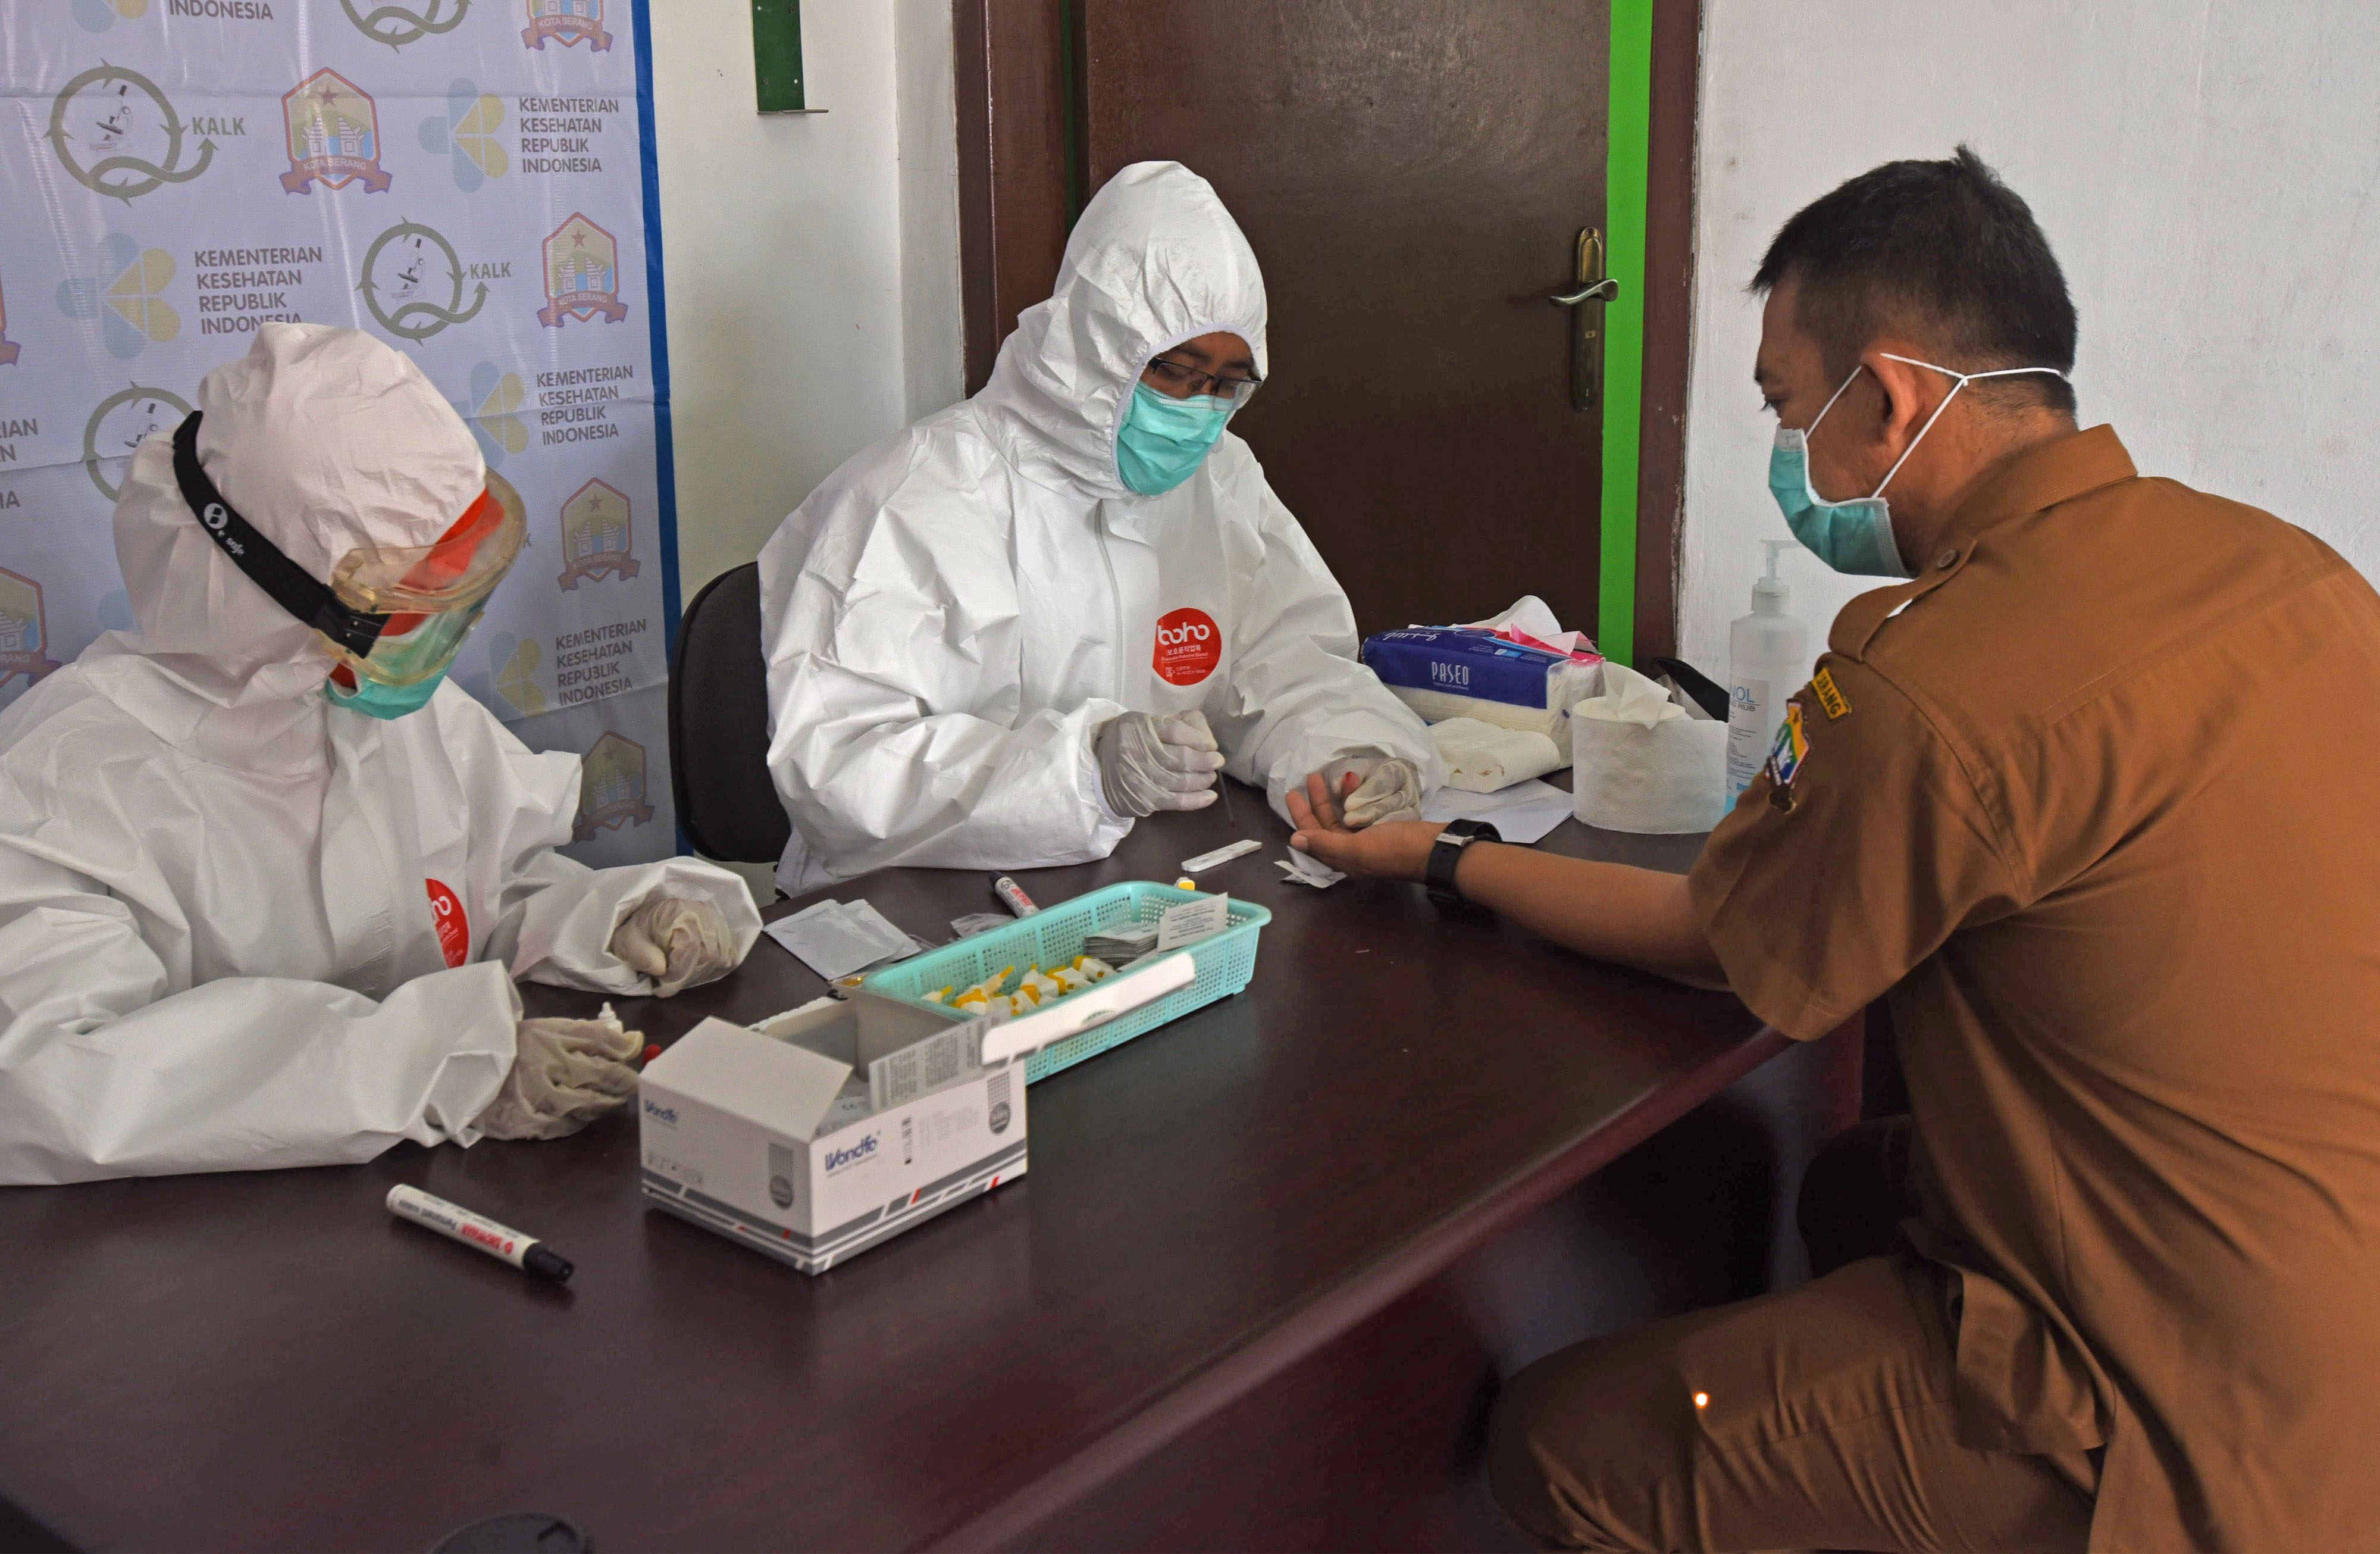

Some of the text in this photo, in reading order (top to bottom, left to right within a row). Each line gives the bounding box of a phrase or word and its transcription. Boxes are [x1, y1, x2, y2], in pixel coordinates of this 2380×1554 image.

[169, 0, 273, 20] INDONESIA
[538, 17, 594, 30] KOTA SERANG
[519, 98, 619, 112] KEMENTERIAN
[192, 117, 246, 136] KALK
[520, 118, 602, 133] KESEHATAN
[521, 138, 589, 152] REPUBLIK
[303, 158, 367, 171] KOTA SERANG
[522, 158, 602, 173] INDONESIA
[195, 247, 322, 267] KEMENTERIAN
[196, 269, 302, 289] KESEHATAN
[470, 262, 511, 280] KALK
[199, 292, 287, 312] REPUBLIK
[537, 365, 633, 387] KEMENTERIAN
[538, 385, 619, 407] KESEHATAN
[541, 405, 606, 426] REPUBLIK
[542, 423, 619, 446] INDONESIA
[556, 618, 646, 650] KEMENTERIAN
[1157, 622, 1210, 646] boho
[557, 640, 632, 669] KESEHATAN
[557, 661, 620, 687] REPUBLIK
[1432, 661, 1470, 686] PASEO
[558, 677, 632, 706] INDONESIA
